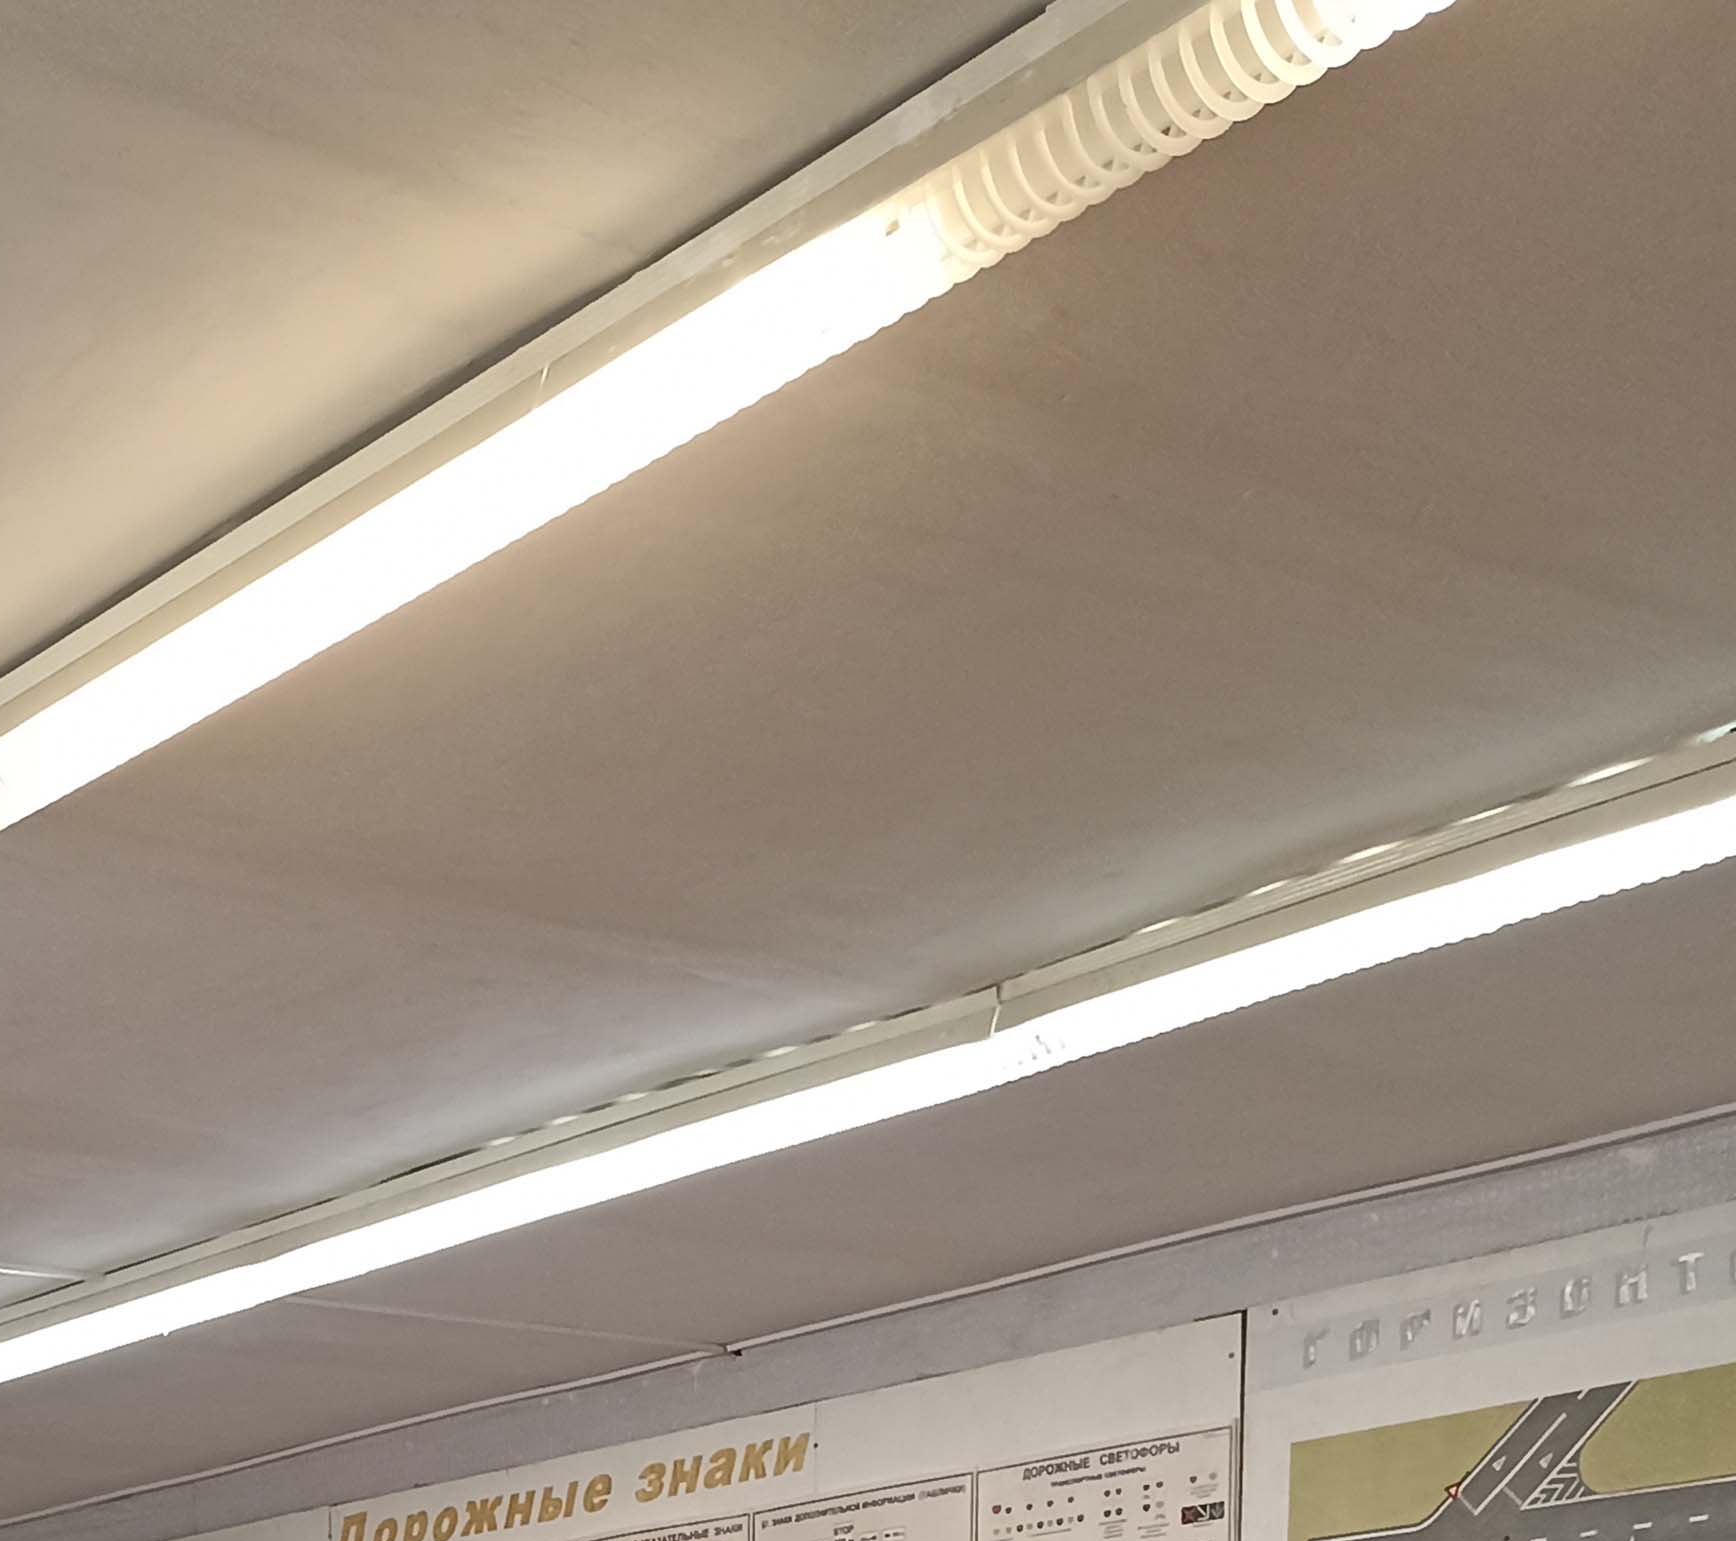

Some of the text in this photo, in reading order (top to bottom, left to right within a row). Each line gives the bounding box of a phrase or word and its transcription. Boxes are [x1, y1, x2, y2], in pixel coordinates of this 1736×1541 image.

[1302, 1251, 1736, 1369] ГОРИЗОНТ
[634, 1432, 811, 1502] знаки
[1023, 1441, 1180, 1481] ДОРОЖНЫЕ СВЕТОФОРЫ
